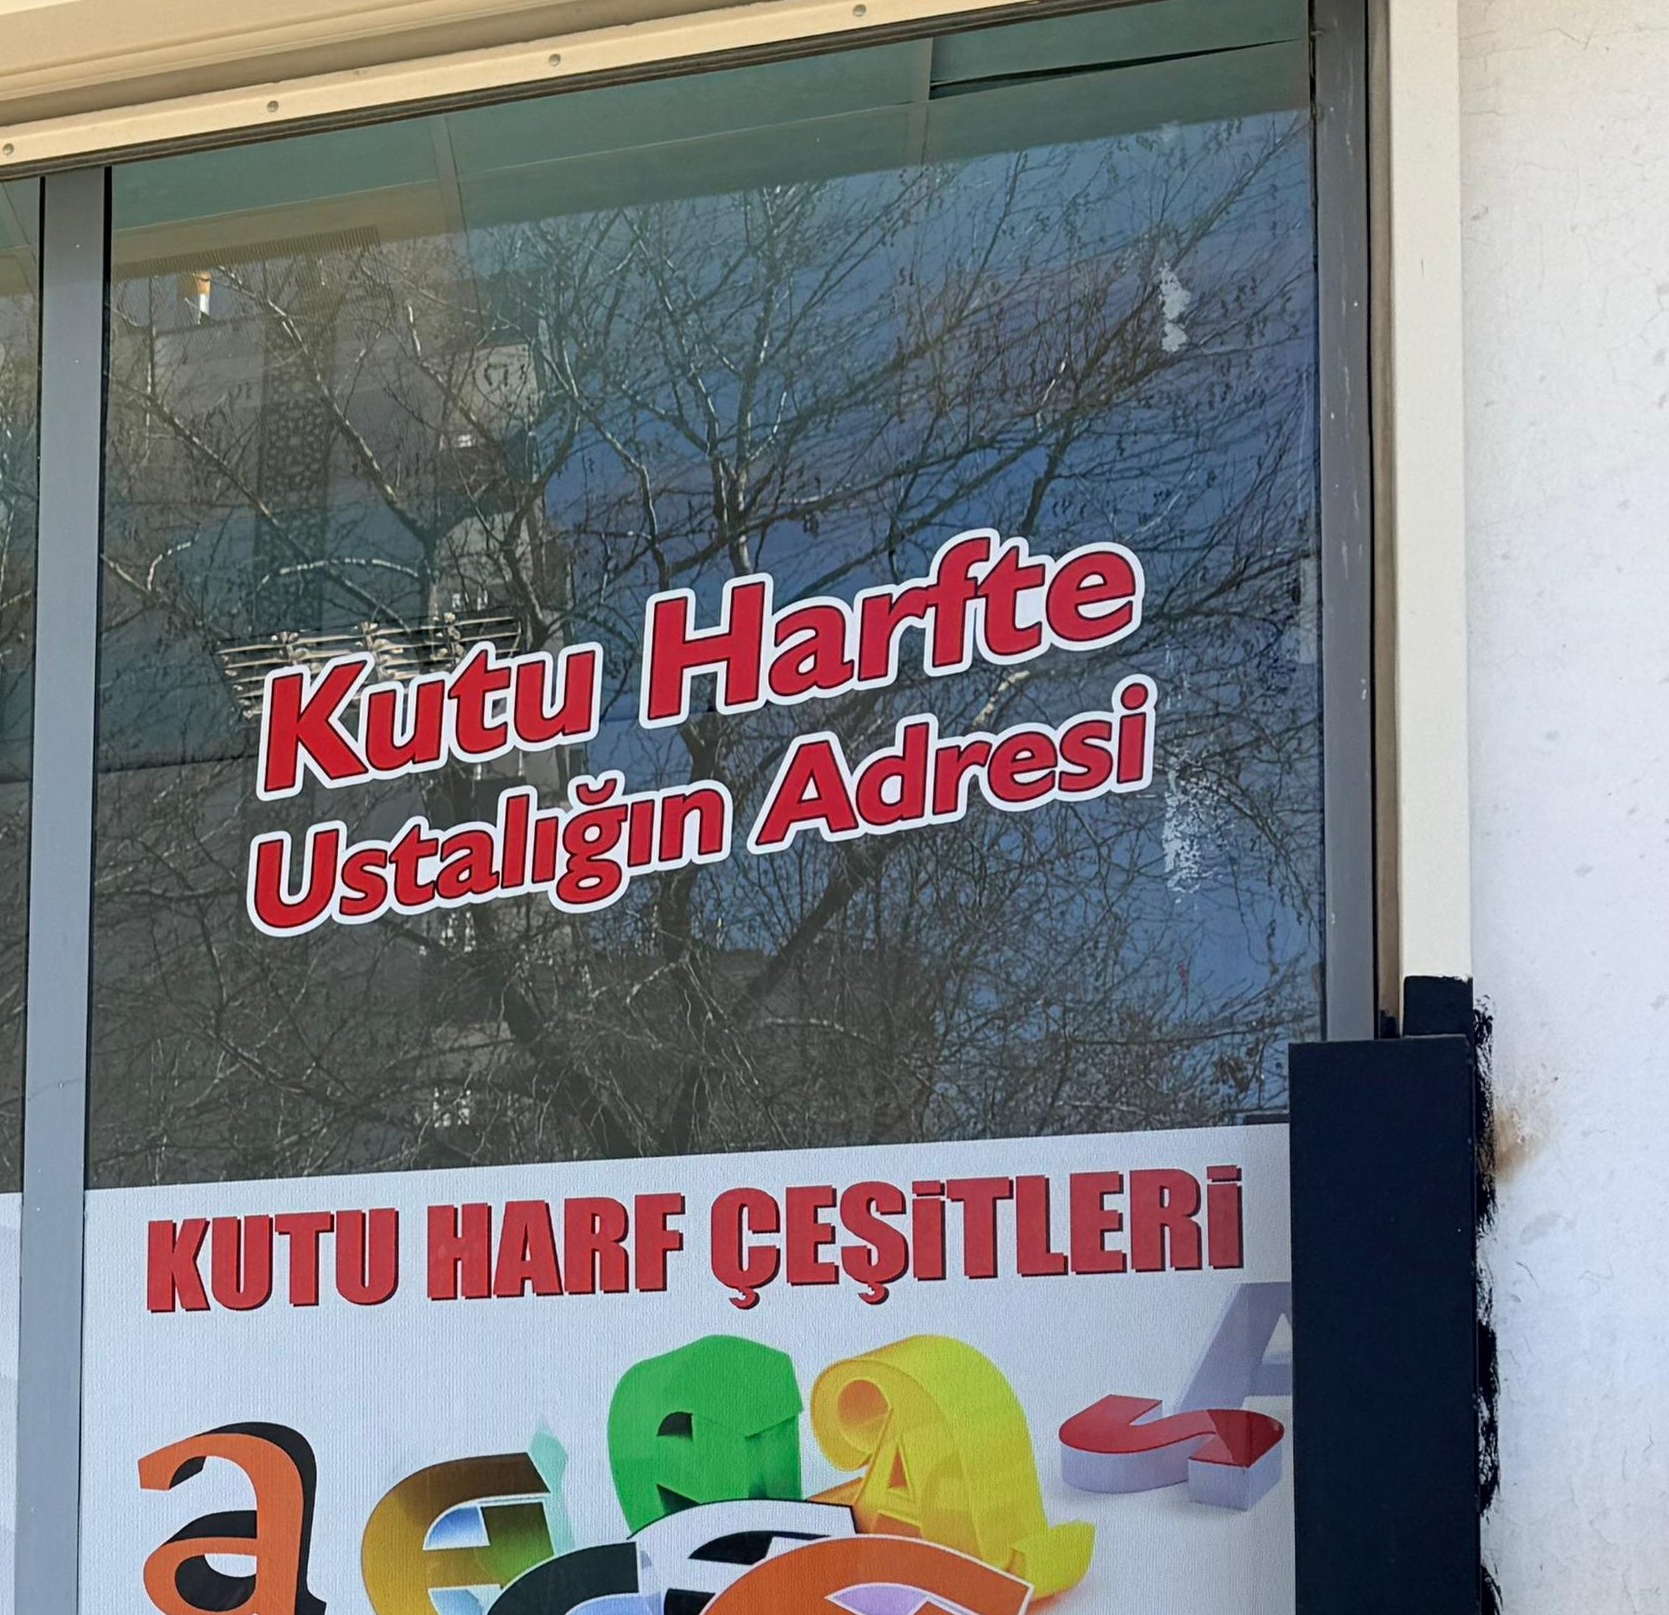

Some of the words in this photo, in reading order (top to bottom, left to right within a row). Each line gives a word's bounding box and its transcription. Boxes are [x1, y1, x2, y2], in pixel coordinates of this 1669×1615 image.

[255, 637, 604, 801] Kutu
[639, 526, 1145, 732] Harfte
[247, 771, 731, 940] Ustalığın
[748, 674, 1158, 856] Adresi
[146, 1207, 400, 1313] KUTU
[427, 1192, 686, 1301] HARF
